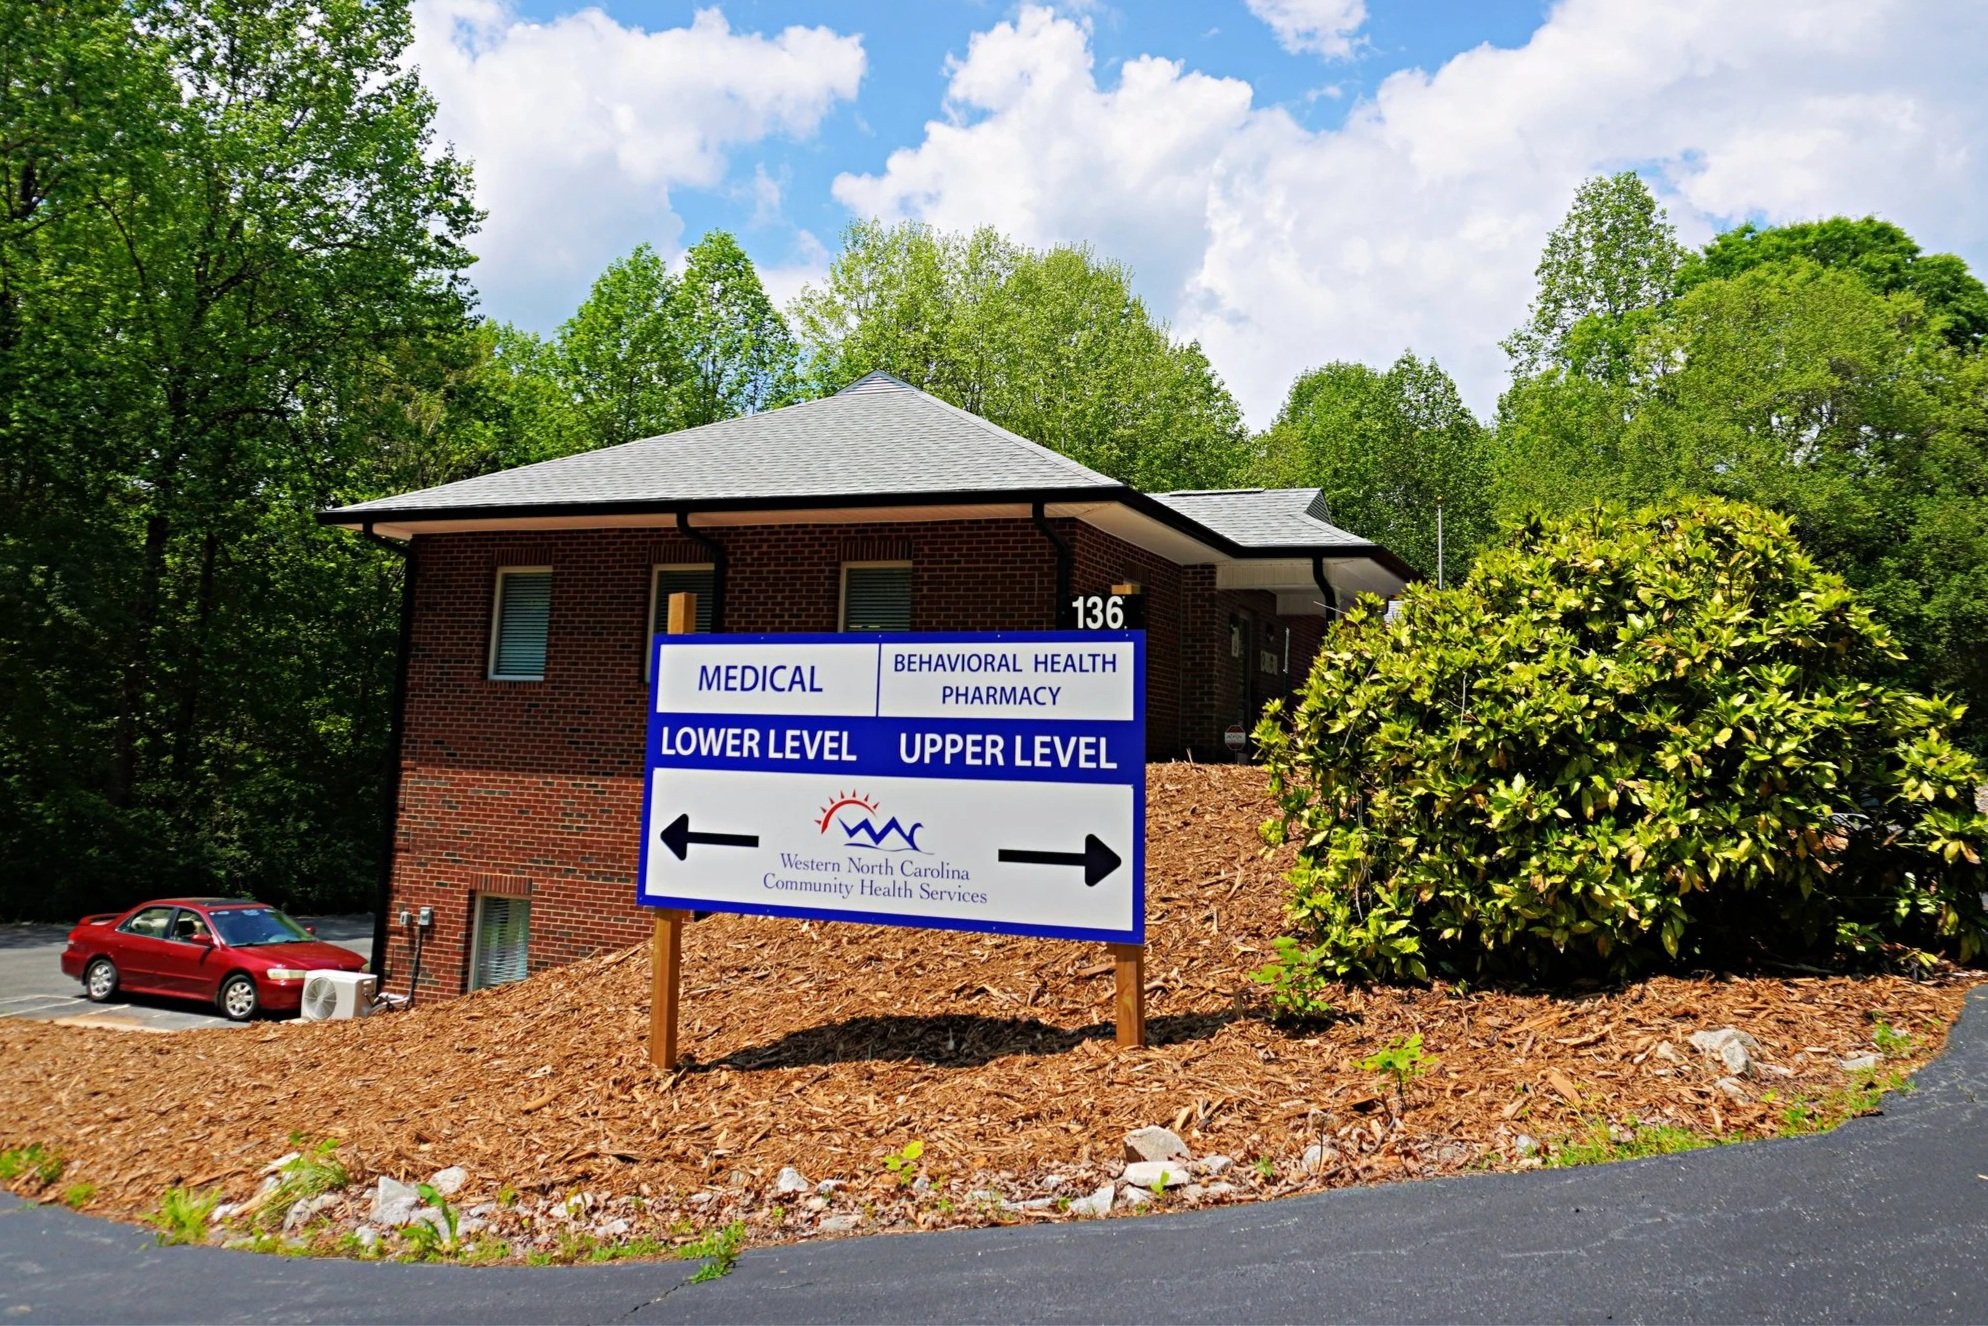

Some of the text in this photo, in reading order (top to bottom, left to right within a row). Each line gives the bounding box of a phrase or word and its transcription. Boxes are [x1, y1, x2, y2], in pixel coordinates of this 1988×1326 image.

[1072, 595, 1124, 630] 136
[893, 653, 1117, 673] BEHAVIORAL HEALTH
[698, 664, 824, 693] MEDICAL
[941, 685, 1062, 706] PHARMACY
[661, 726, 857, 761] LOWER LEVEL
[899, 732, 1118, 769] UPPER LEVEL
[780, 853, 970, 881] Western North Carolina
[763, 872, 988, 904] Community Health Services
